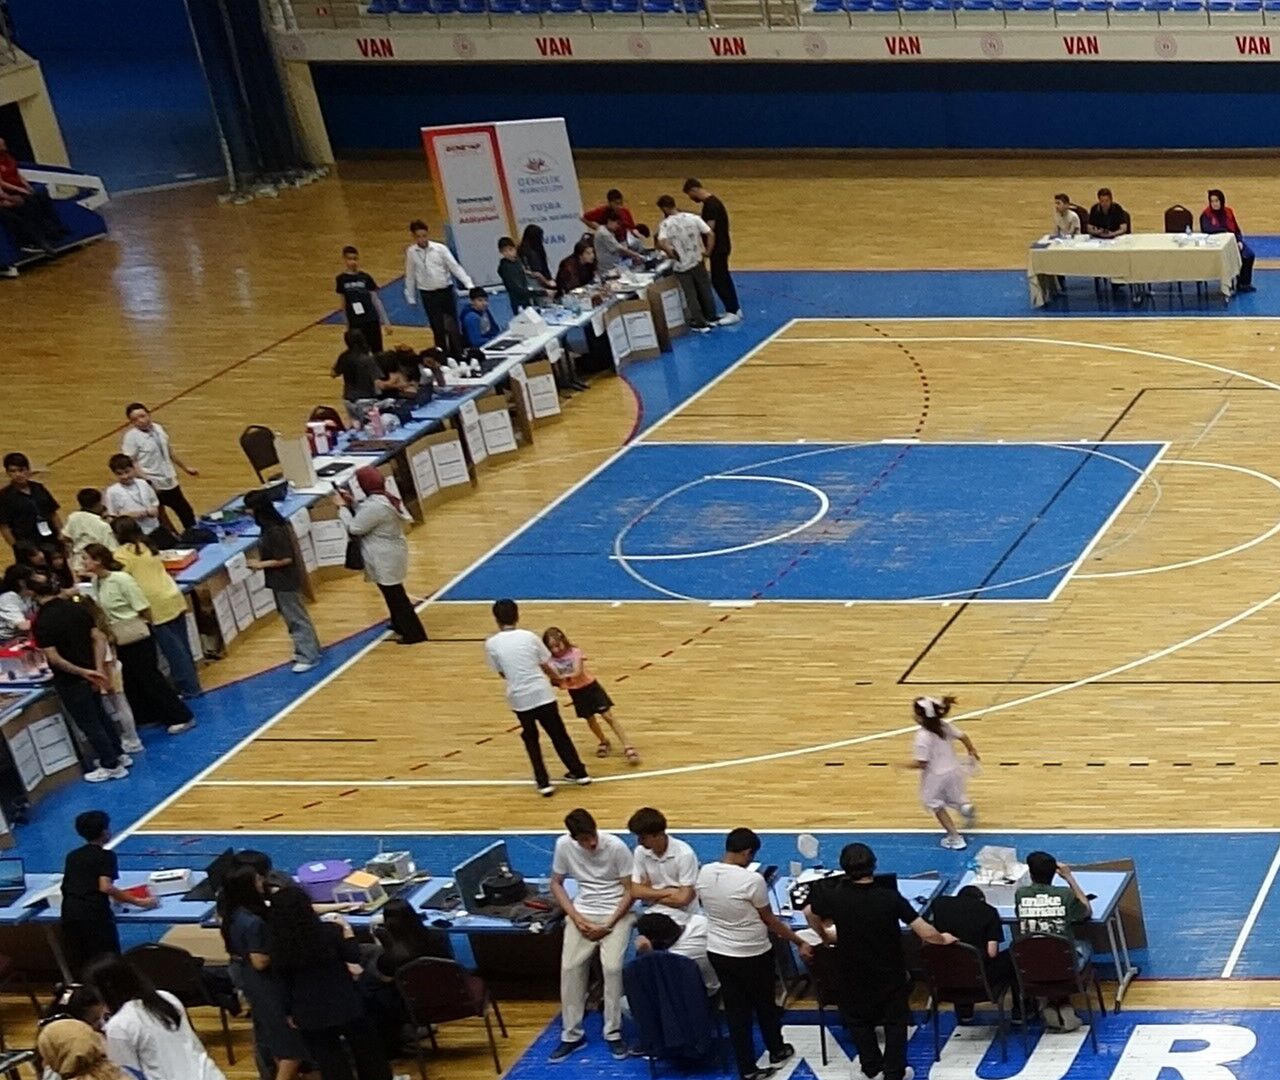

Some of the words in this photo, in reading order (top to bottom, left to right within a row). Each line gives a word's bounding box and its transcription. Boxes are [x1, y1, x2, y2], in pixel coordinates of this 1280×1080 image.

[357, 38, 394, 57] VAN
[535, 37, 572, 55] VAN
[709, 37, 746, 55] VAN
[886, 37, 921, 54] VAN
[1064, 37, 1100, 54] VAN
[1237, 36, 1272, 54] VAN
